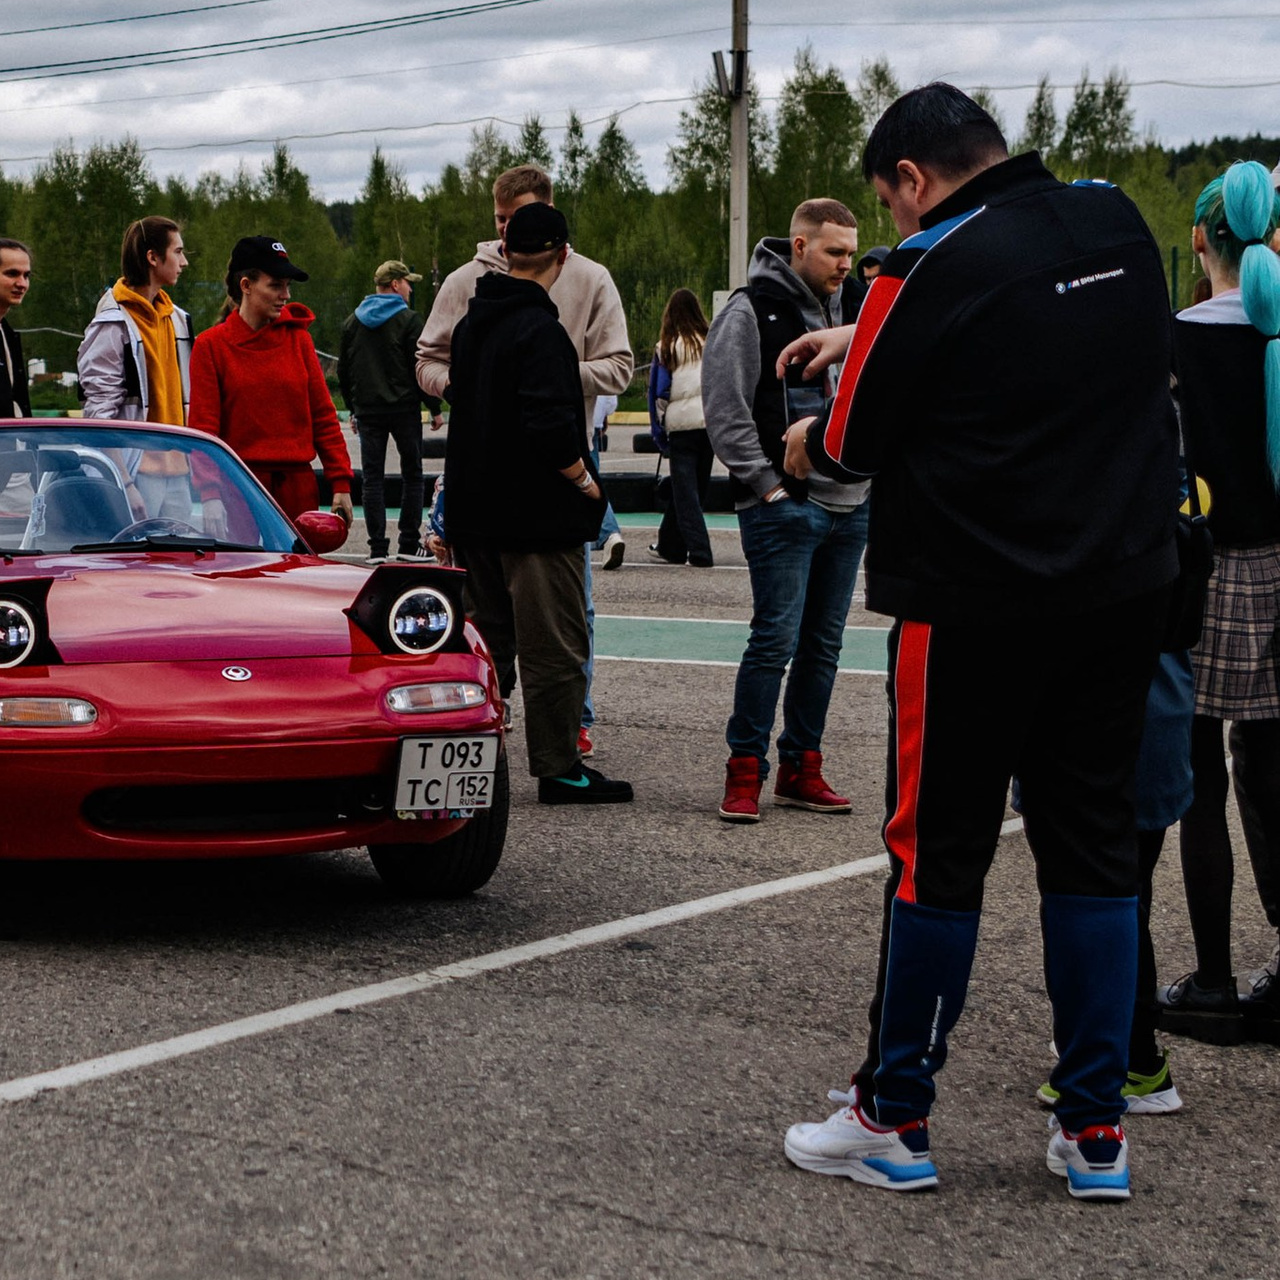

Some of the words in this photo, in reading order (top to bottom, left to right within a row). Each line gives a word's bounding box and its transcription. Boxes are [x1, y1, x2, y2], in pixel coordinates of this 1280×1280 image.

[1080, 275, 1095, 285] BMW
[1095, 268, 1124, 281] Motorsport
[441, 741, 484, 769] 093
[456, 775, 489, 797] 152
[459, 798, 476, 806] RUS
